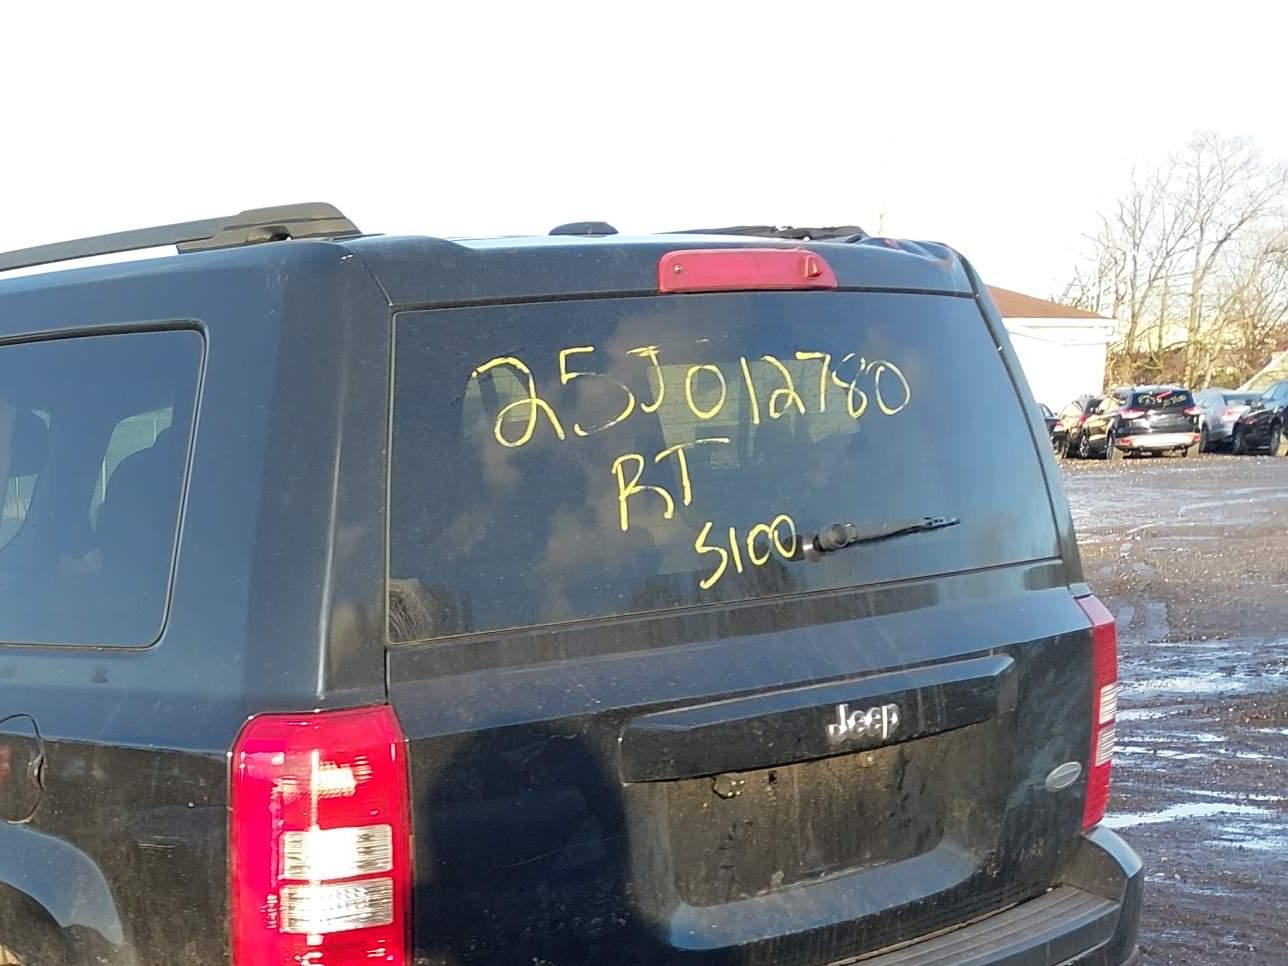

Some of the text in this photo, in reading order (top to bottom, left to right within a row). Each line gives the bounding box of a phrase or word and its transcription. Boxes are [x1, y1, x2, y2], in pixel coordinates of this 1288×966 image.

[471, 345, 912, 448] 25J012780
[611, 437, 731, 531] RT
[694, 513, 797, 590] S100
[826, 702, 901, 742] Jeep
